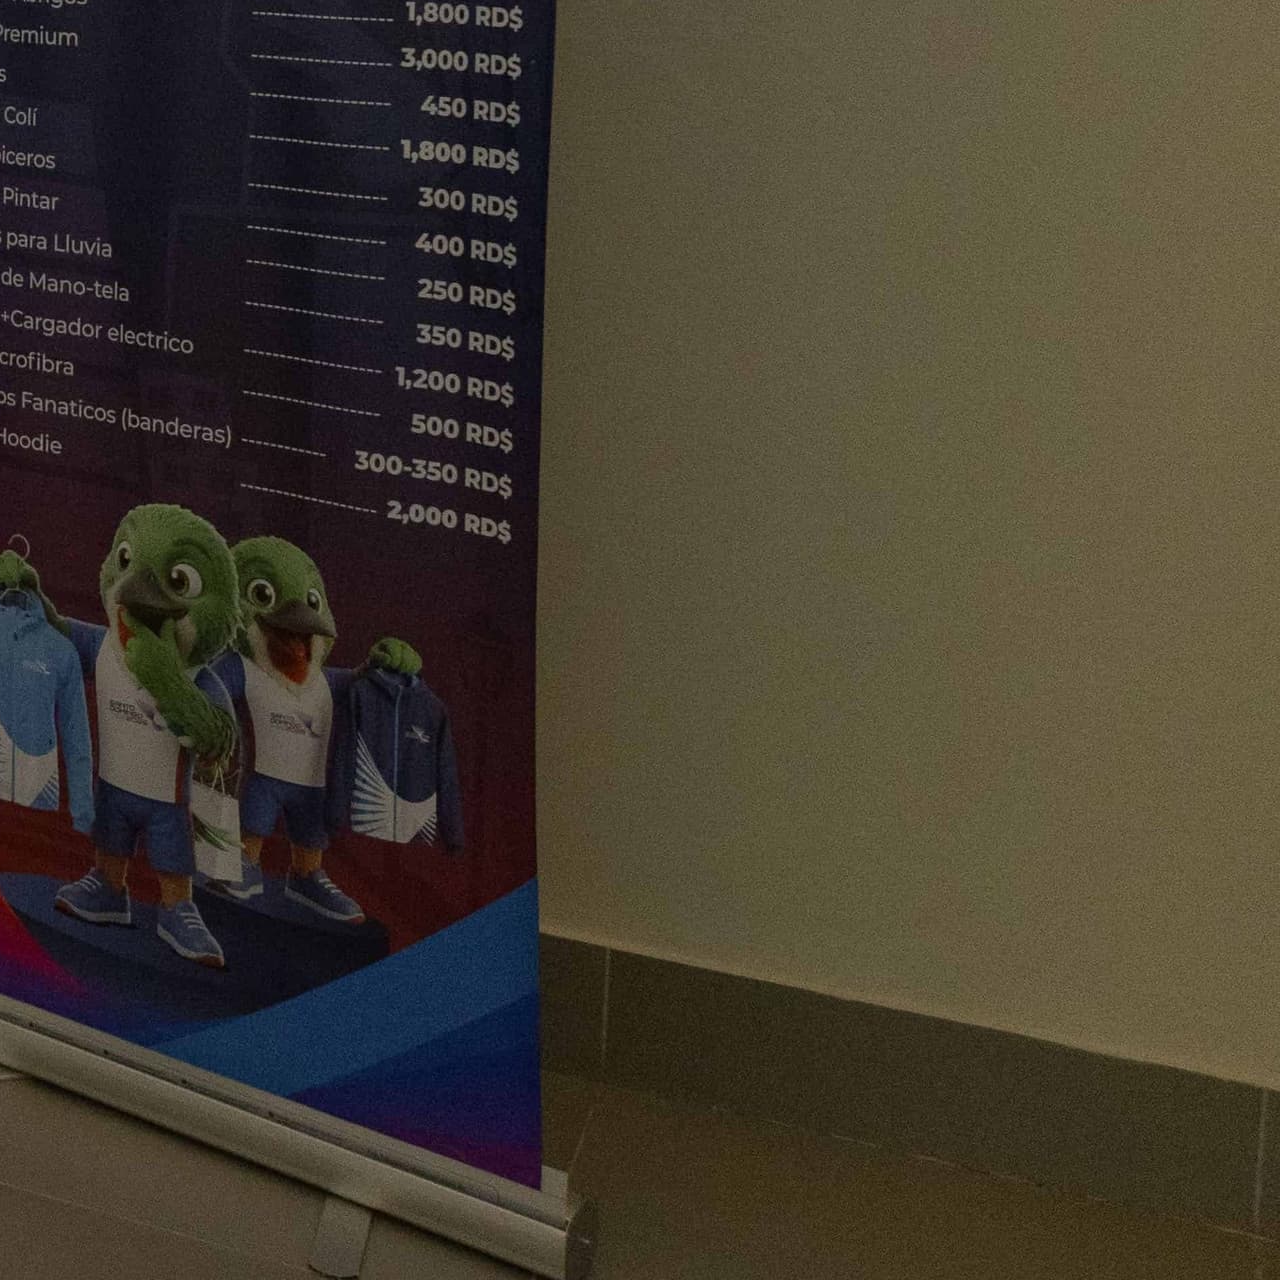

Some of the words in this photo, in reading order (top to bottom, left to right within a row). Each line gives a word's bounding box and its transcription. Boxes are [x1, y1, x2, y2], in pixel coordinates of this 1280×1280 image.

[405, 1, 470, 27] 1,800
[475, 4, 523, 32] RD$
[400, 48, 468, 71] 3,000
[474, 53, 522, 80] RD$
[4, 105, 37, 126] Colí
[421, 95, 467, 118] 450
[473, 100, 521, 128] RD$
[400, 138, 466, 164] 1,800
[472, 146, 520, 174] RD$
[3, 187, 59, 211] Pintar
[418, 186, 465, 211] 300
[472, 193, 518, 222] RD$
[6, 231, 47, 251] para
[54, 234, 113, 258] Lluvia
[415, 232, 465, 257] 400
[470, 239, 518, 269] RD$
[1, 267, 24, 287] de
[29, 271, 130, 302] Mano-tela
[417, 278, 463, 303] 250
[469, 285, 517, 315] RD$
[1, 310, 102, 338] +Cargador
[107, 324, 194, 354] electrico
[416, 323, 462, 349] 350
[468, 331, 515, 361] RD$
[394, 366, 461, 393] 1,200
[467, 376, 514, 408] RD$
[21, 391, 117, 424] Fanaticos
[122, 408, 232, 449] (banderas)
[410, 414, 460, 440] 500
[465, 421, 513, 454] RD$
[354, 450, 458, 484] 300-350
[464, 468, 513, 500] RD$
[387, 500, 458, 528] 2,000
[463, 513, 512, 544] RD$
